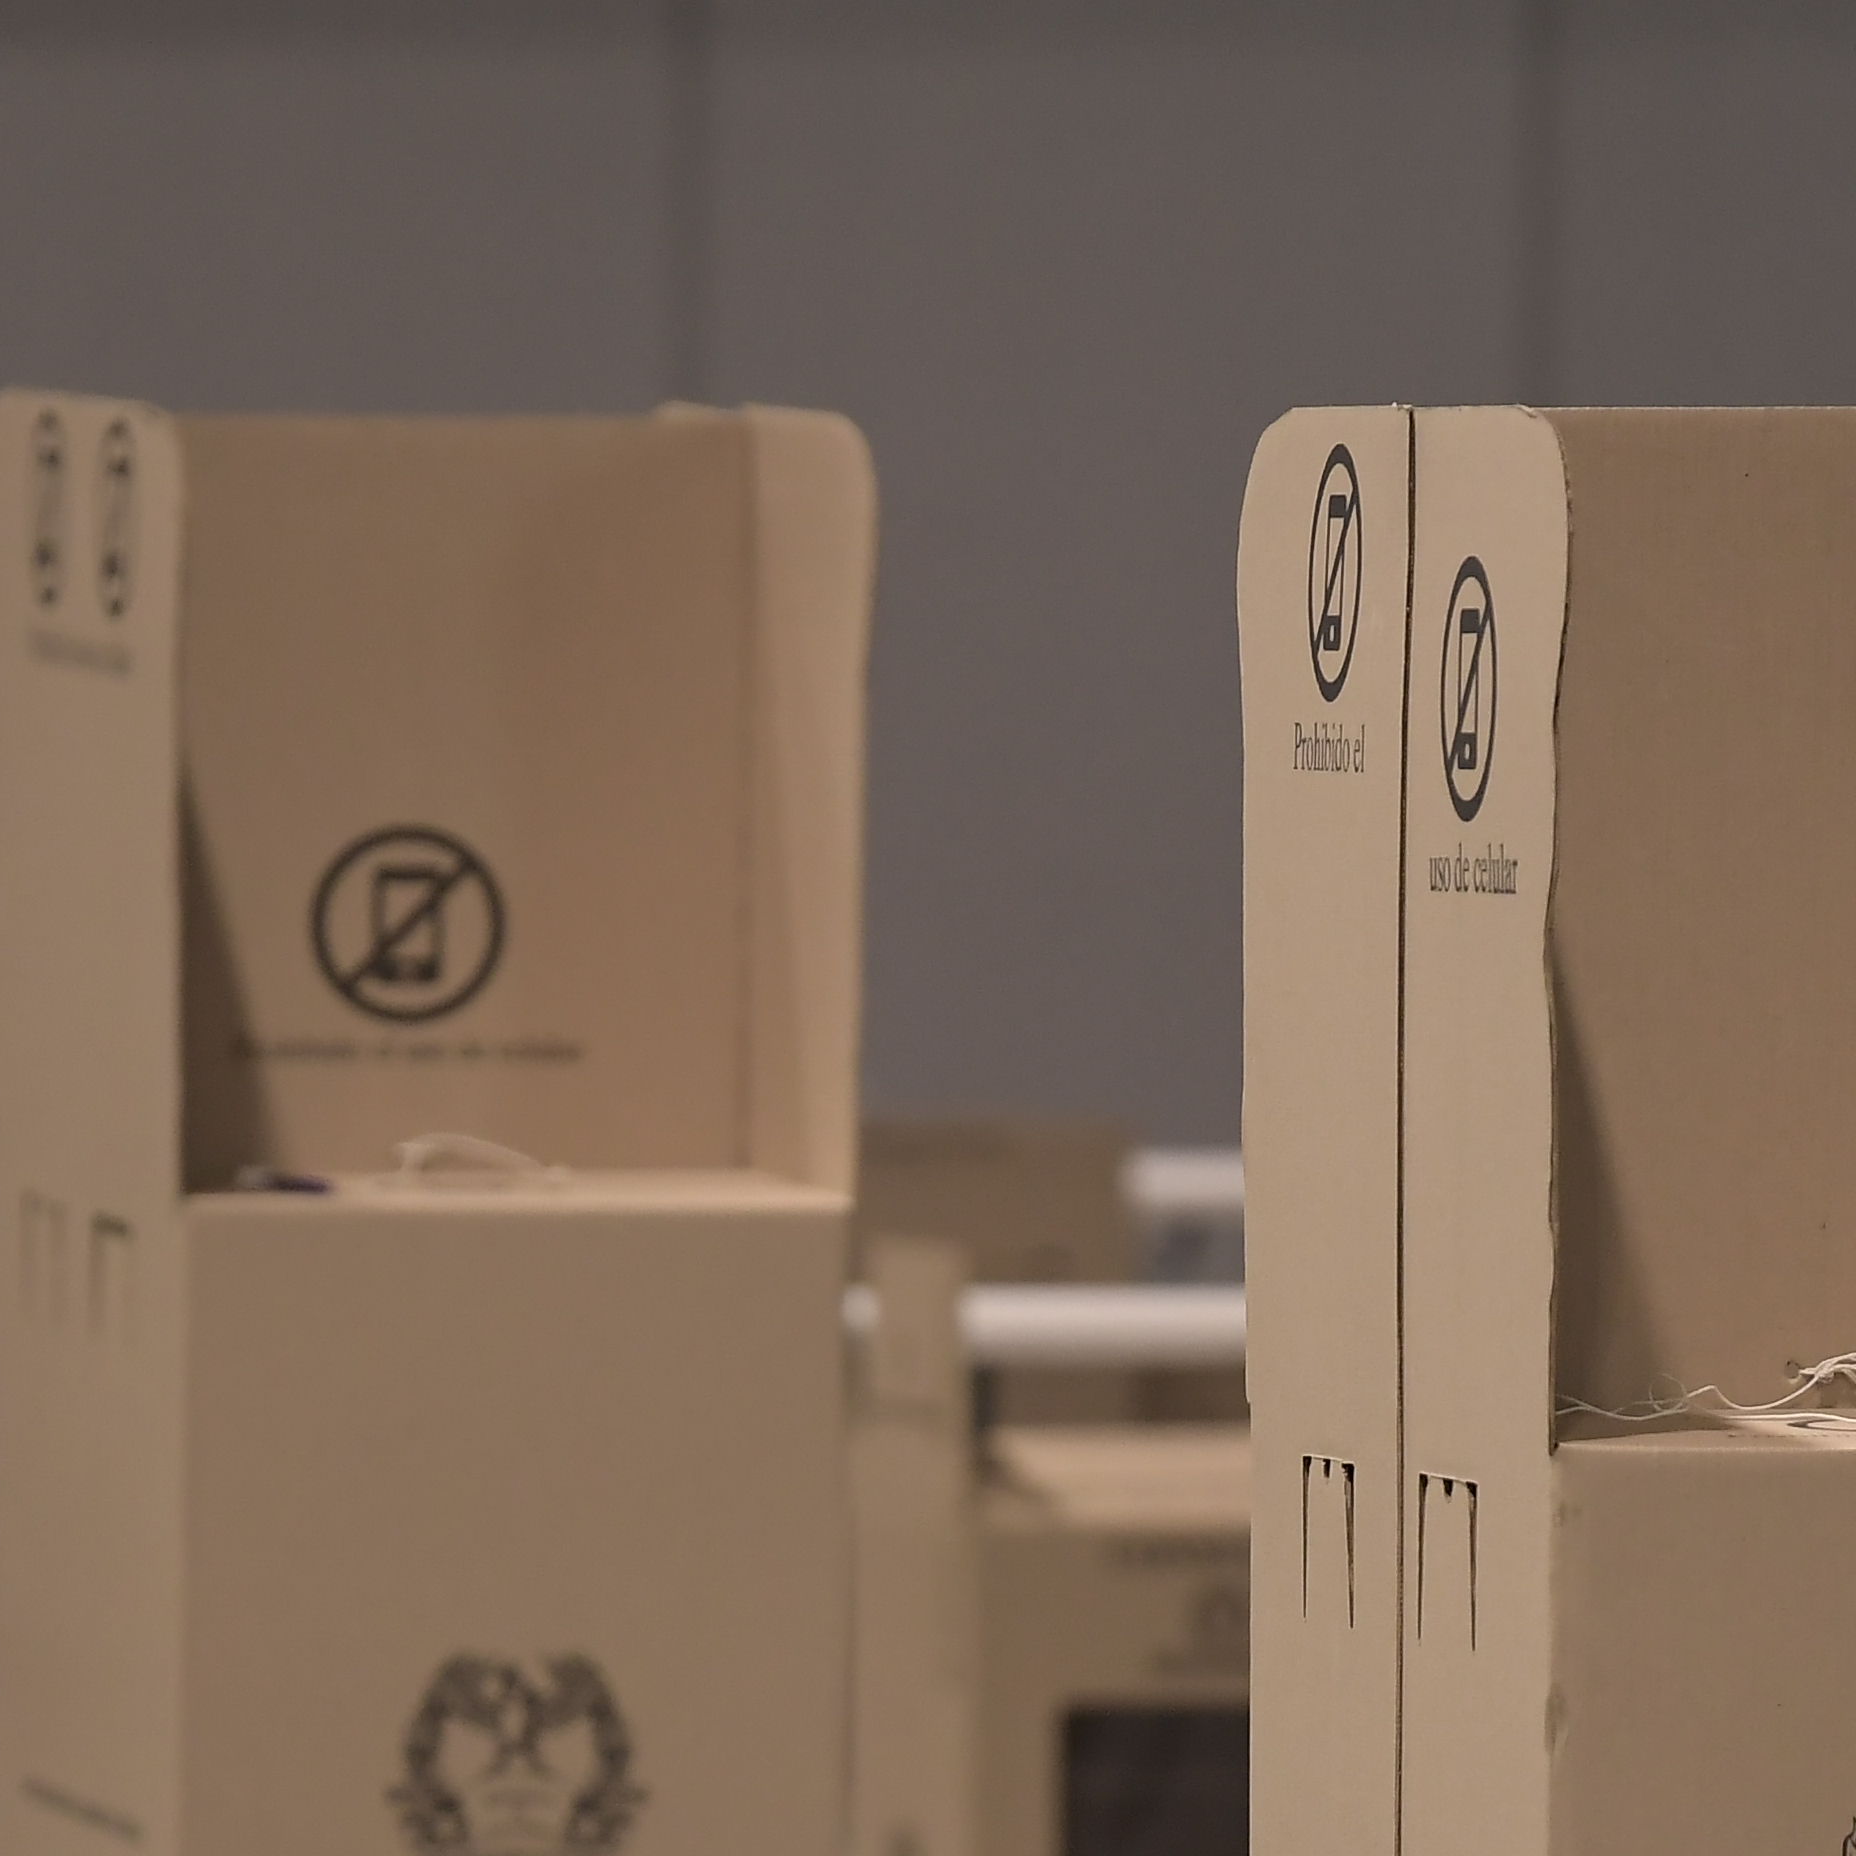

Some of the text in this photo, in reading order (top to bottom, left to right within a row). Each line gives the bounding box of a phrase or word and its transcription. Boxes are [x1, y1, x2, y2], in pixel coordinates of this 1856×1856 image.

[1293, 721, 1365, 773] Prohibido el
[1429, 842, 1518, 894] uso de celular
